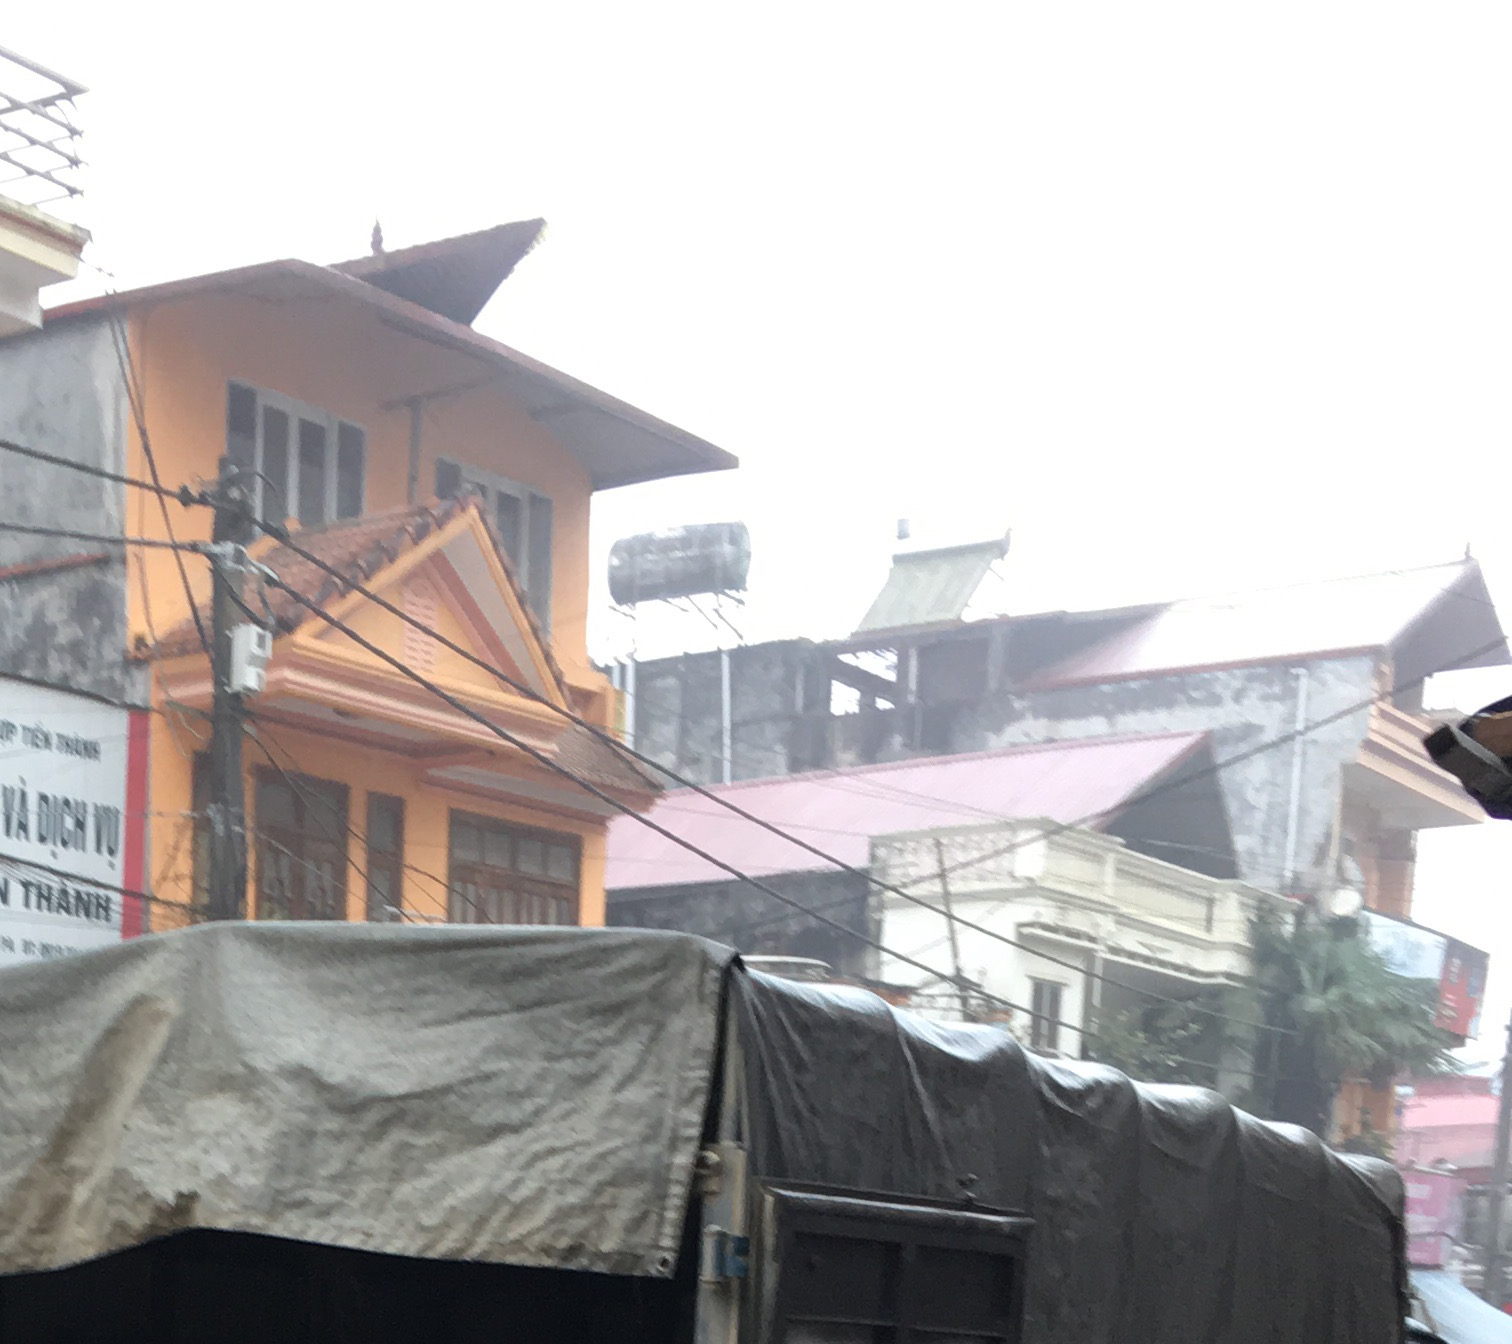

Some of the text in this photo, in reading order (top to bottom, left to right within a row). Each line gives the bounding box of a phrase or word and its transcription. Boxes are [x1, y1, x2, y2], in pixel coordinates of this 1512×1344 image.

[2, 775, 30, 843] VÀ
[37, 791, 87, 860] DỊCH
[93, 802, 121, 871] VỤ
[19, 870, 113, 923] THÀNH
